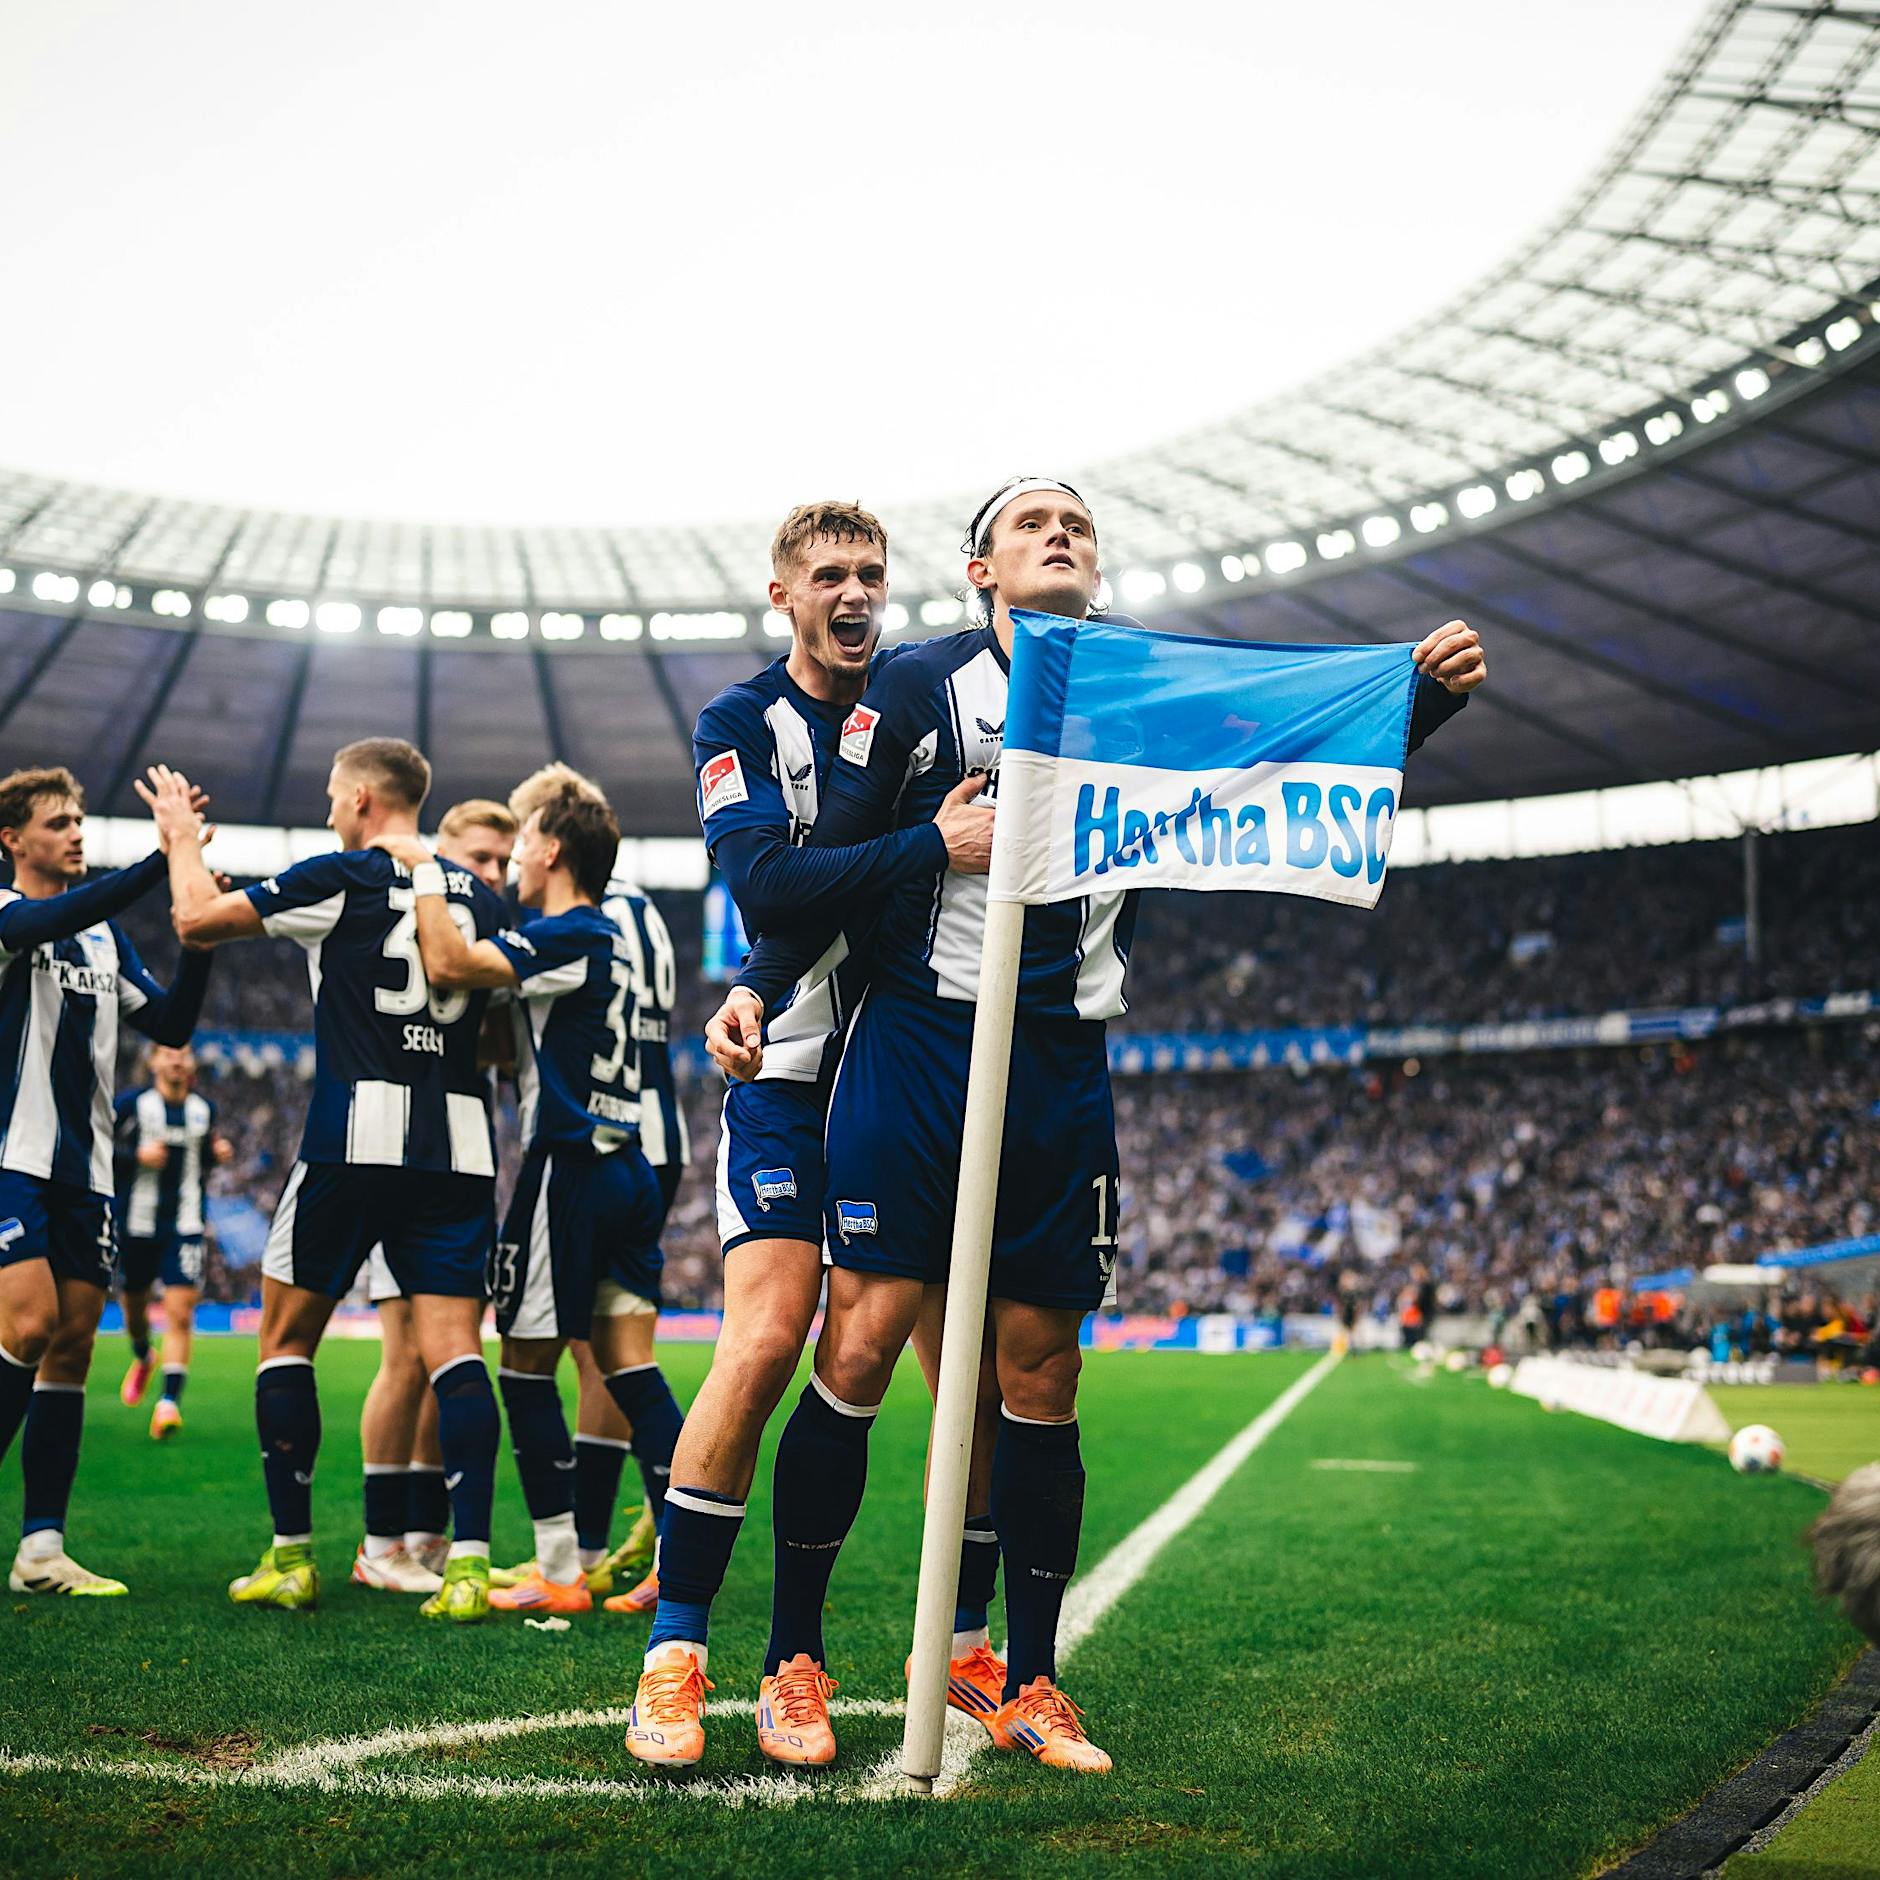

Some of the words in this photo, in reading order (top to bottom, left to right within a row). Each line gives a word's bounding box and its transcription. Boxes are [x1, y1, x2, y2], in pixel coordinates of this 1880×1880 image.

[980, 736, 1003, 744] CASTO
[1074, 783, 1271, 877] Hertha
[1281, 781, 1395, 885] BSC
[761, 1184, 782, 1196] Hertha
[782, 1182, 795, 1193] BSC
[1090, 1174, 1119, 1246] 1
[843, 1218, 863, 1229] Hertha
[863, 1218, 875, 1230] BSC
